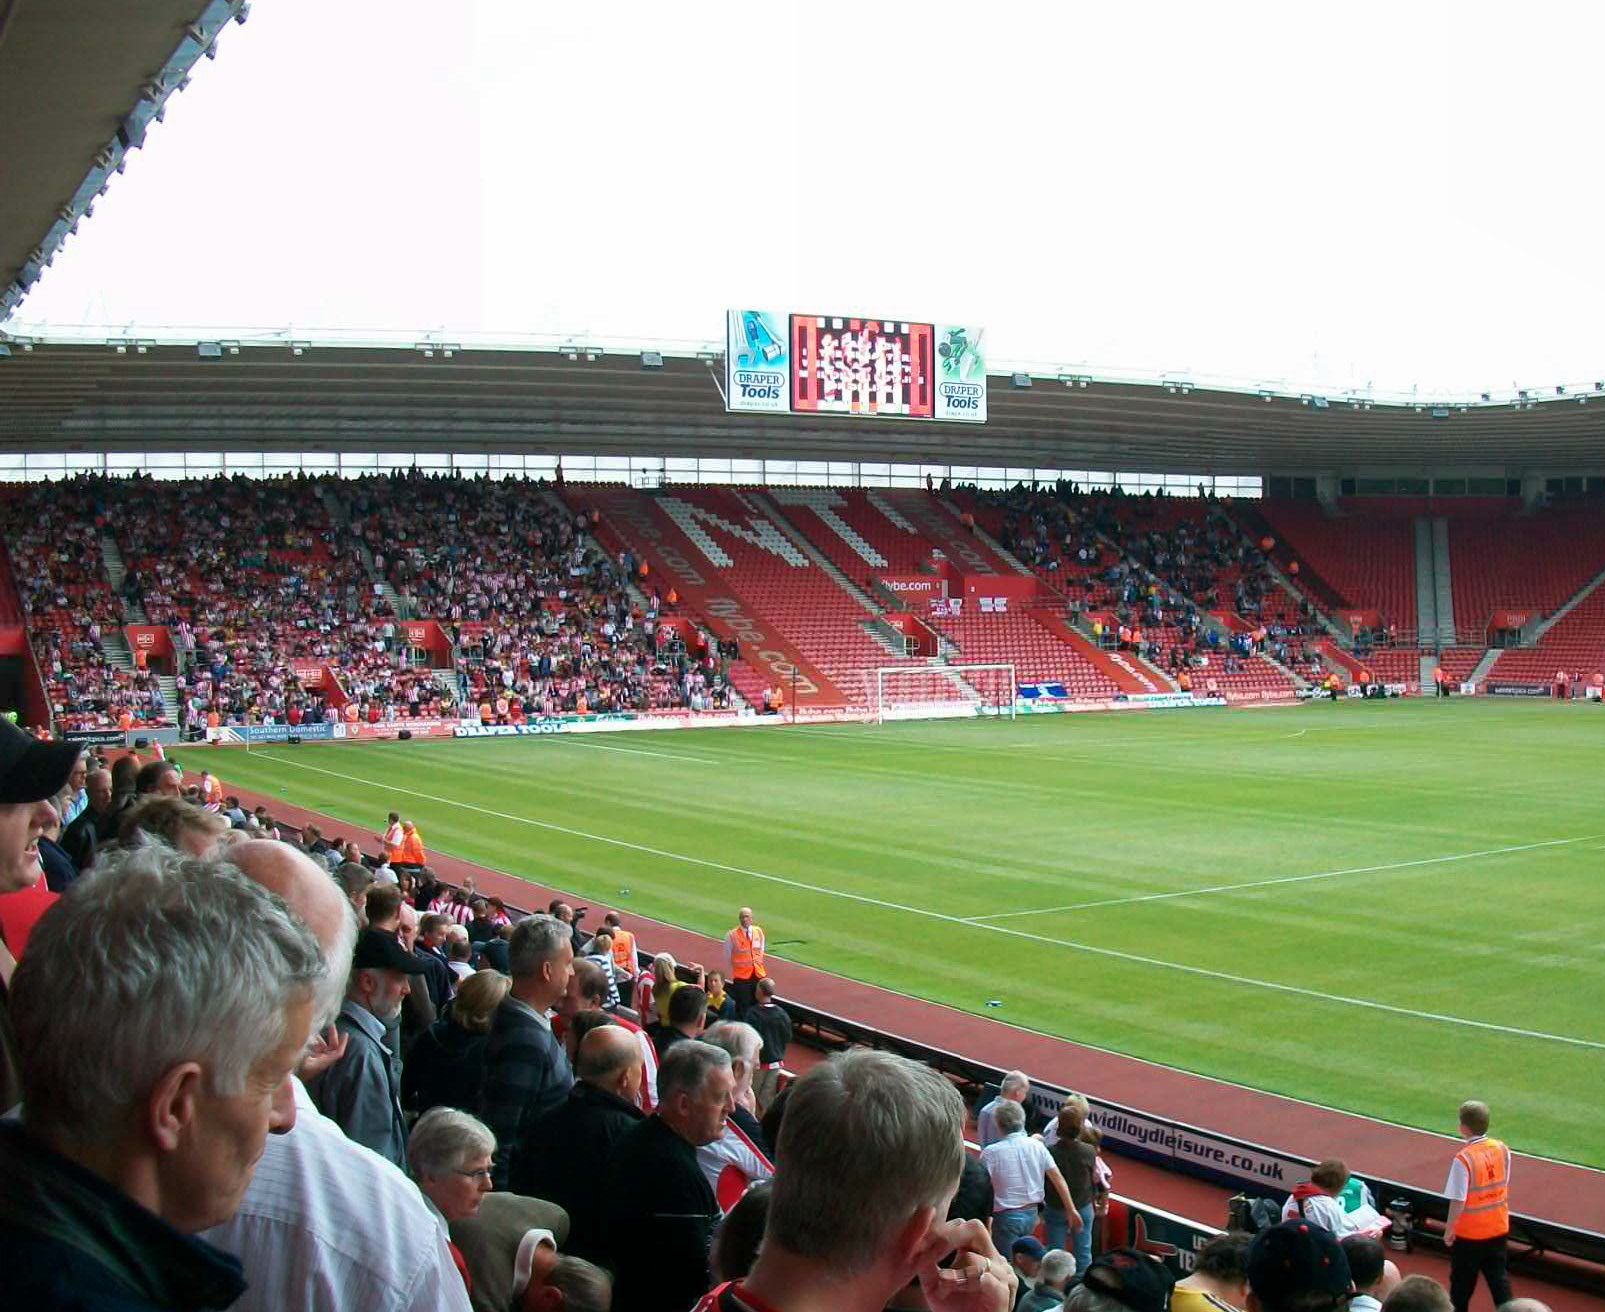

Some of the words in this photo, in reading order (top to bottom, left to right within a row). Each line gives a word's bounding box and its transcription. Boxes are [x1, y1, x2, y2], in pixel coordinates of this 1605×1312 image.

[738, 373, 780, 385] DRAPER
[740, 384, 780, 399] Tools
[944, 385, 979, 396] DRAPER
[945, 395, 979, 410] Tools
[249, 726, 287, 734] Southern
[289, 724, 327, 733] Domestic
[454, 725, 518, 737] DRAPER
